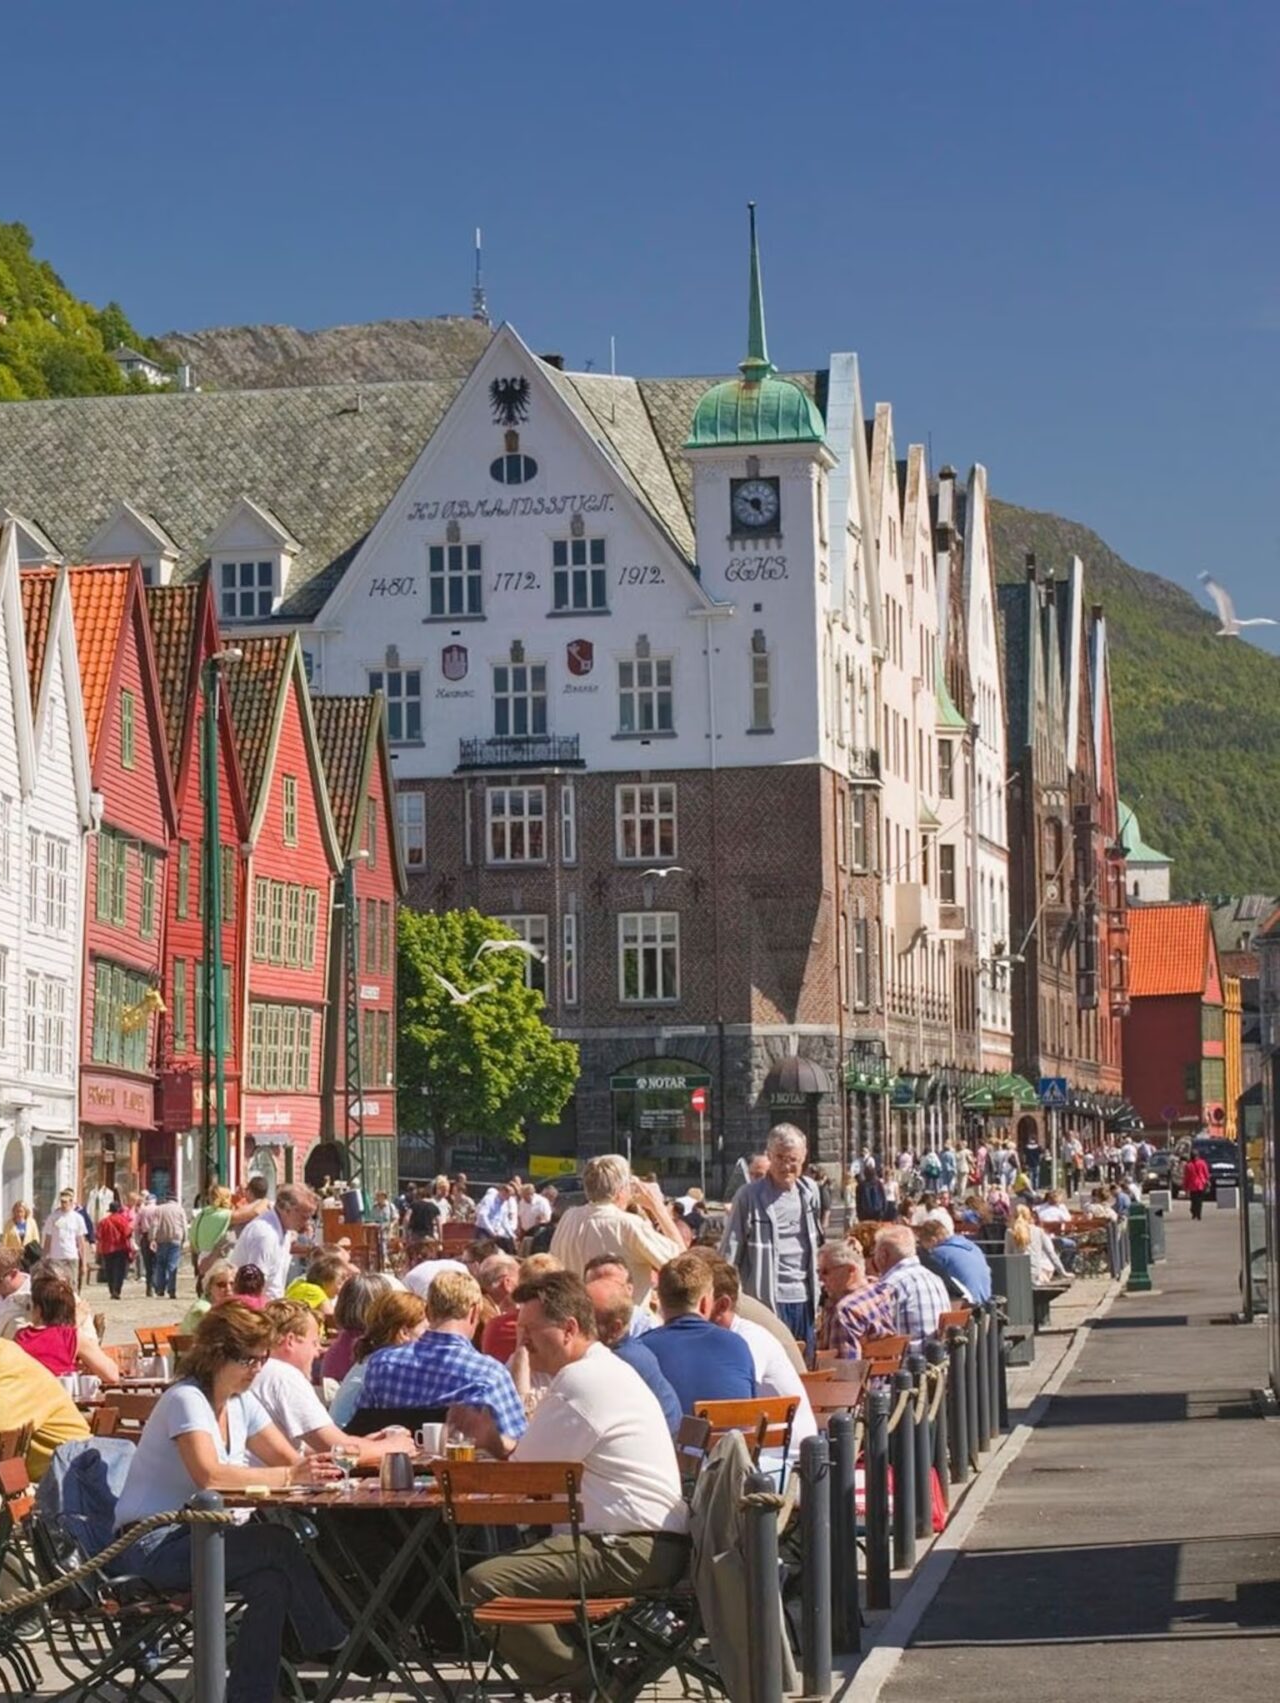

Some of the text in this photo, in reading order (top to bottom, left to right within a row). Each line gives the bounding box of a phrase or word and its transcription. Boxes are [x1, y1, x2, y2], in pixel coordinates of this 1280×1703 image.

[368, 566, 665, 597] 1480. 1712. 1912.
[648, 1076, 687, 1089] NOTAR
